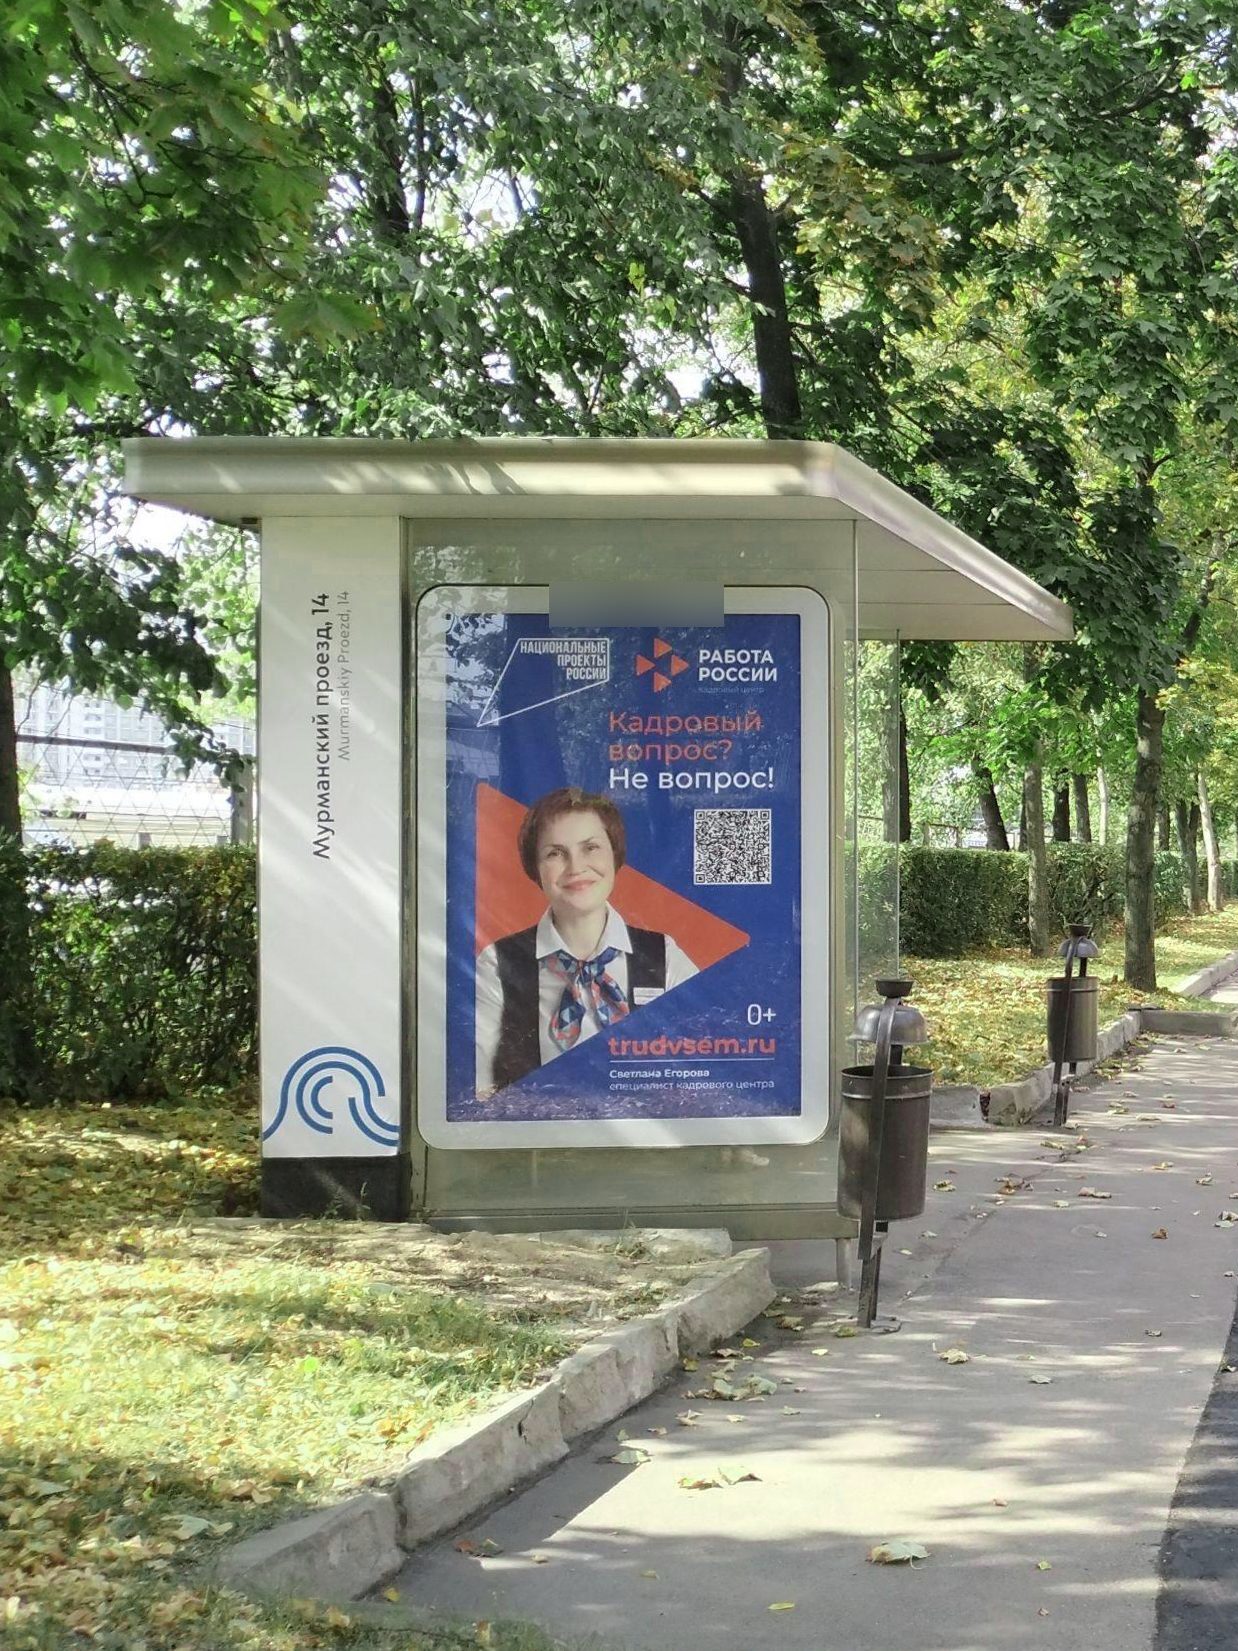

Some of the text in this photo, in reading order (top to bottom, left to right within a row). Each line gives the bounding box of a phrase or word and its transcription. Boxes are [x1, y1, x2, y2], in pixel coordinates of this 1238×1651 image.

[520, 641, 606, 655] НАЦИОНАЛЬНЫЕ
[698, 649, 774, 665] РАБОТА
[557, 654, 606, 667] ПРОЕКТЫ
[337, 591, 353, 761] Murmanskiy Proezd, 14
[566, 667, 606, 680] РОССИИ
[698, 667, 778, 682] РОССИИ
[312, 593, 335, 860] Мурманский проезд, 14
[609, 709, 761, 737] Кадровый
[609, 739, 733, 765] вопрос?
[609, 767, 774, 793] Не вопрос!
[747, 1003, 777, 1025] 0+
[608, 1035, 776, 1056] trudvsem.ru
[609, 1068, 710, 1079] Светлана Егорова
[609, 1080, 775, 1091] специалист кадрового центра
